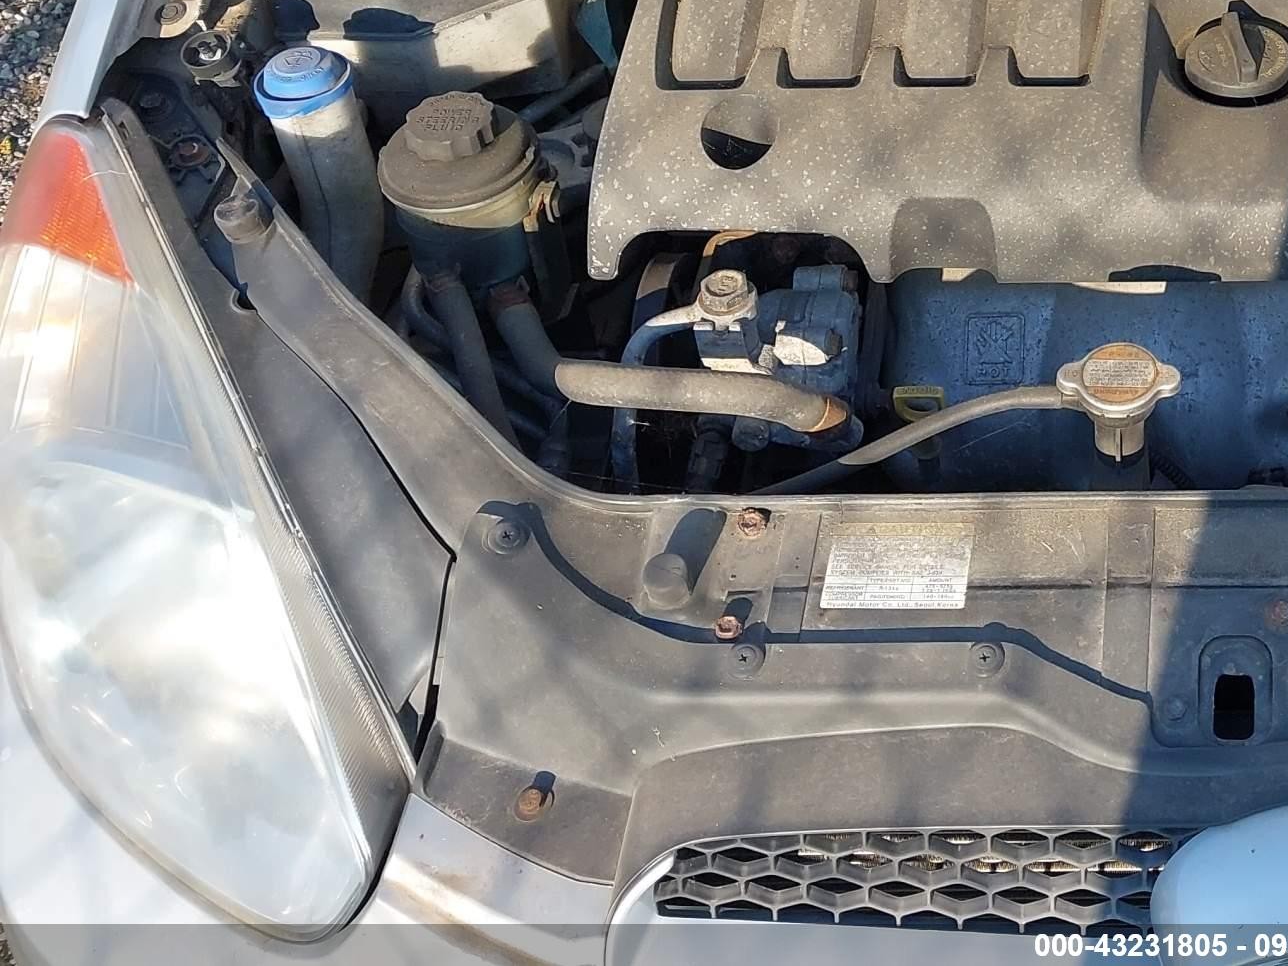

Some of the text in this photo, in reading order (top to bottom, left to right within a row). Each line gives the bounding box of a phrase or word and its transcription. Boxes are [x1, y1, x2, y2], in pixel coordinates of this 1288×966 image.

[432, 108, 472, 116] POWER
[416, 116, 481, 124] STEERING
[423, 123, 464, 131] FLUID
[976, 366, 1011, 379] HOT
